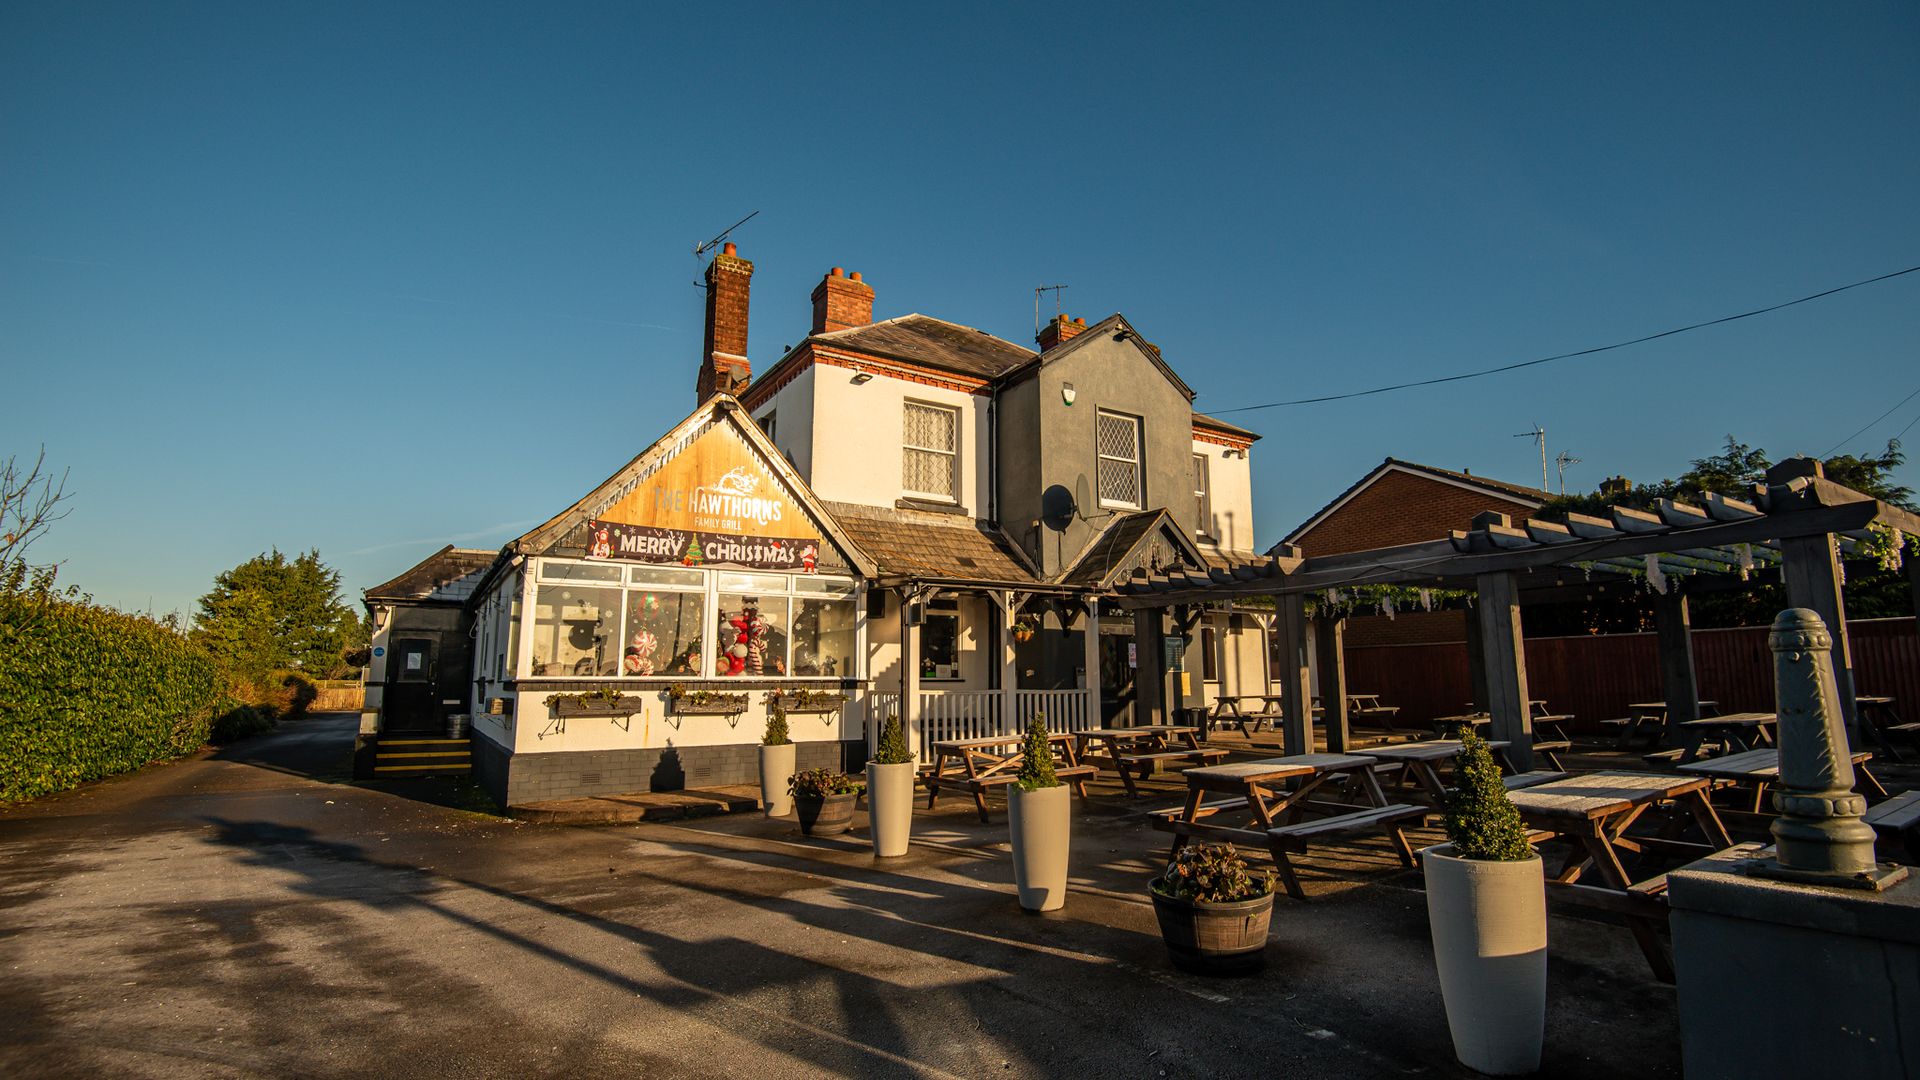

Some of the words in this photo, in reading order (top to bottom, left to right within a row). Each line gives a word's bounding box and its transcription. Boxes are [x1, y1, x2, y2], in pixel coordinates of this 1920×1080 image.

[655, 486, 683, 512] THE
[688, 487, 782, 525] HAWTHORNS
[695, 516, 720, 529] FAMILY
[721, 519, 742, 531] GRILL
[620, 533, 683, 556] MERRY
[705, 541, 796, 564] CHRISTMAS
